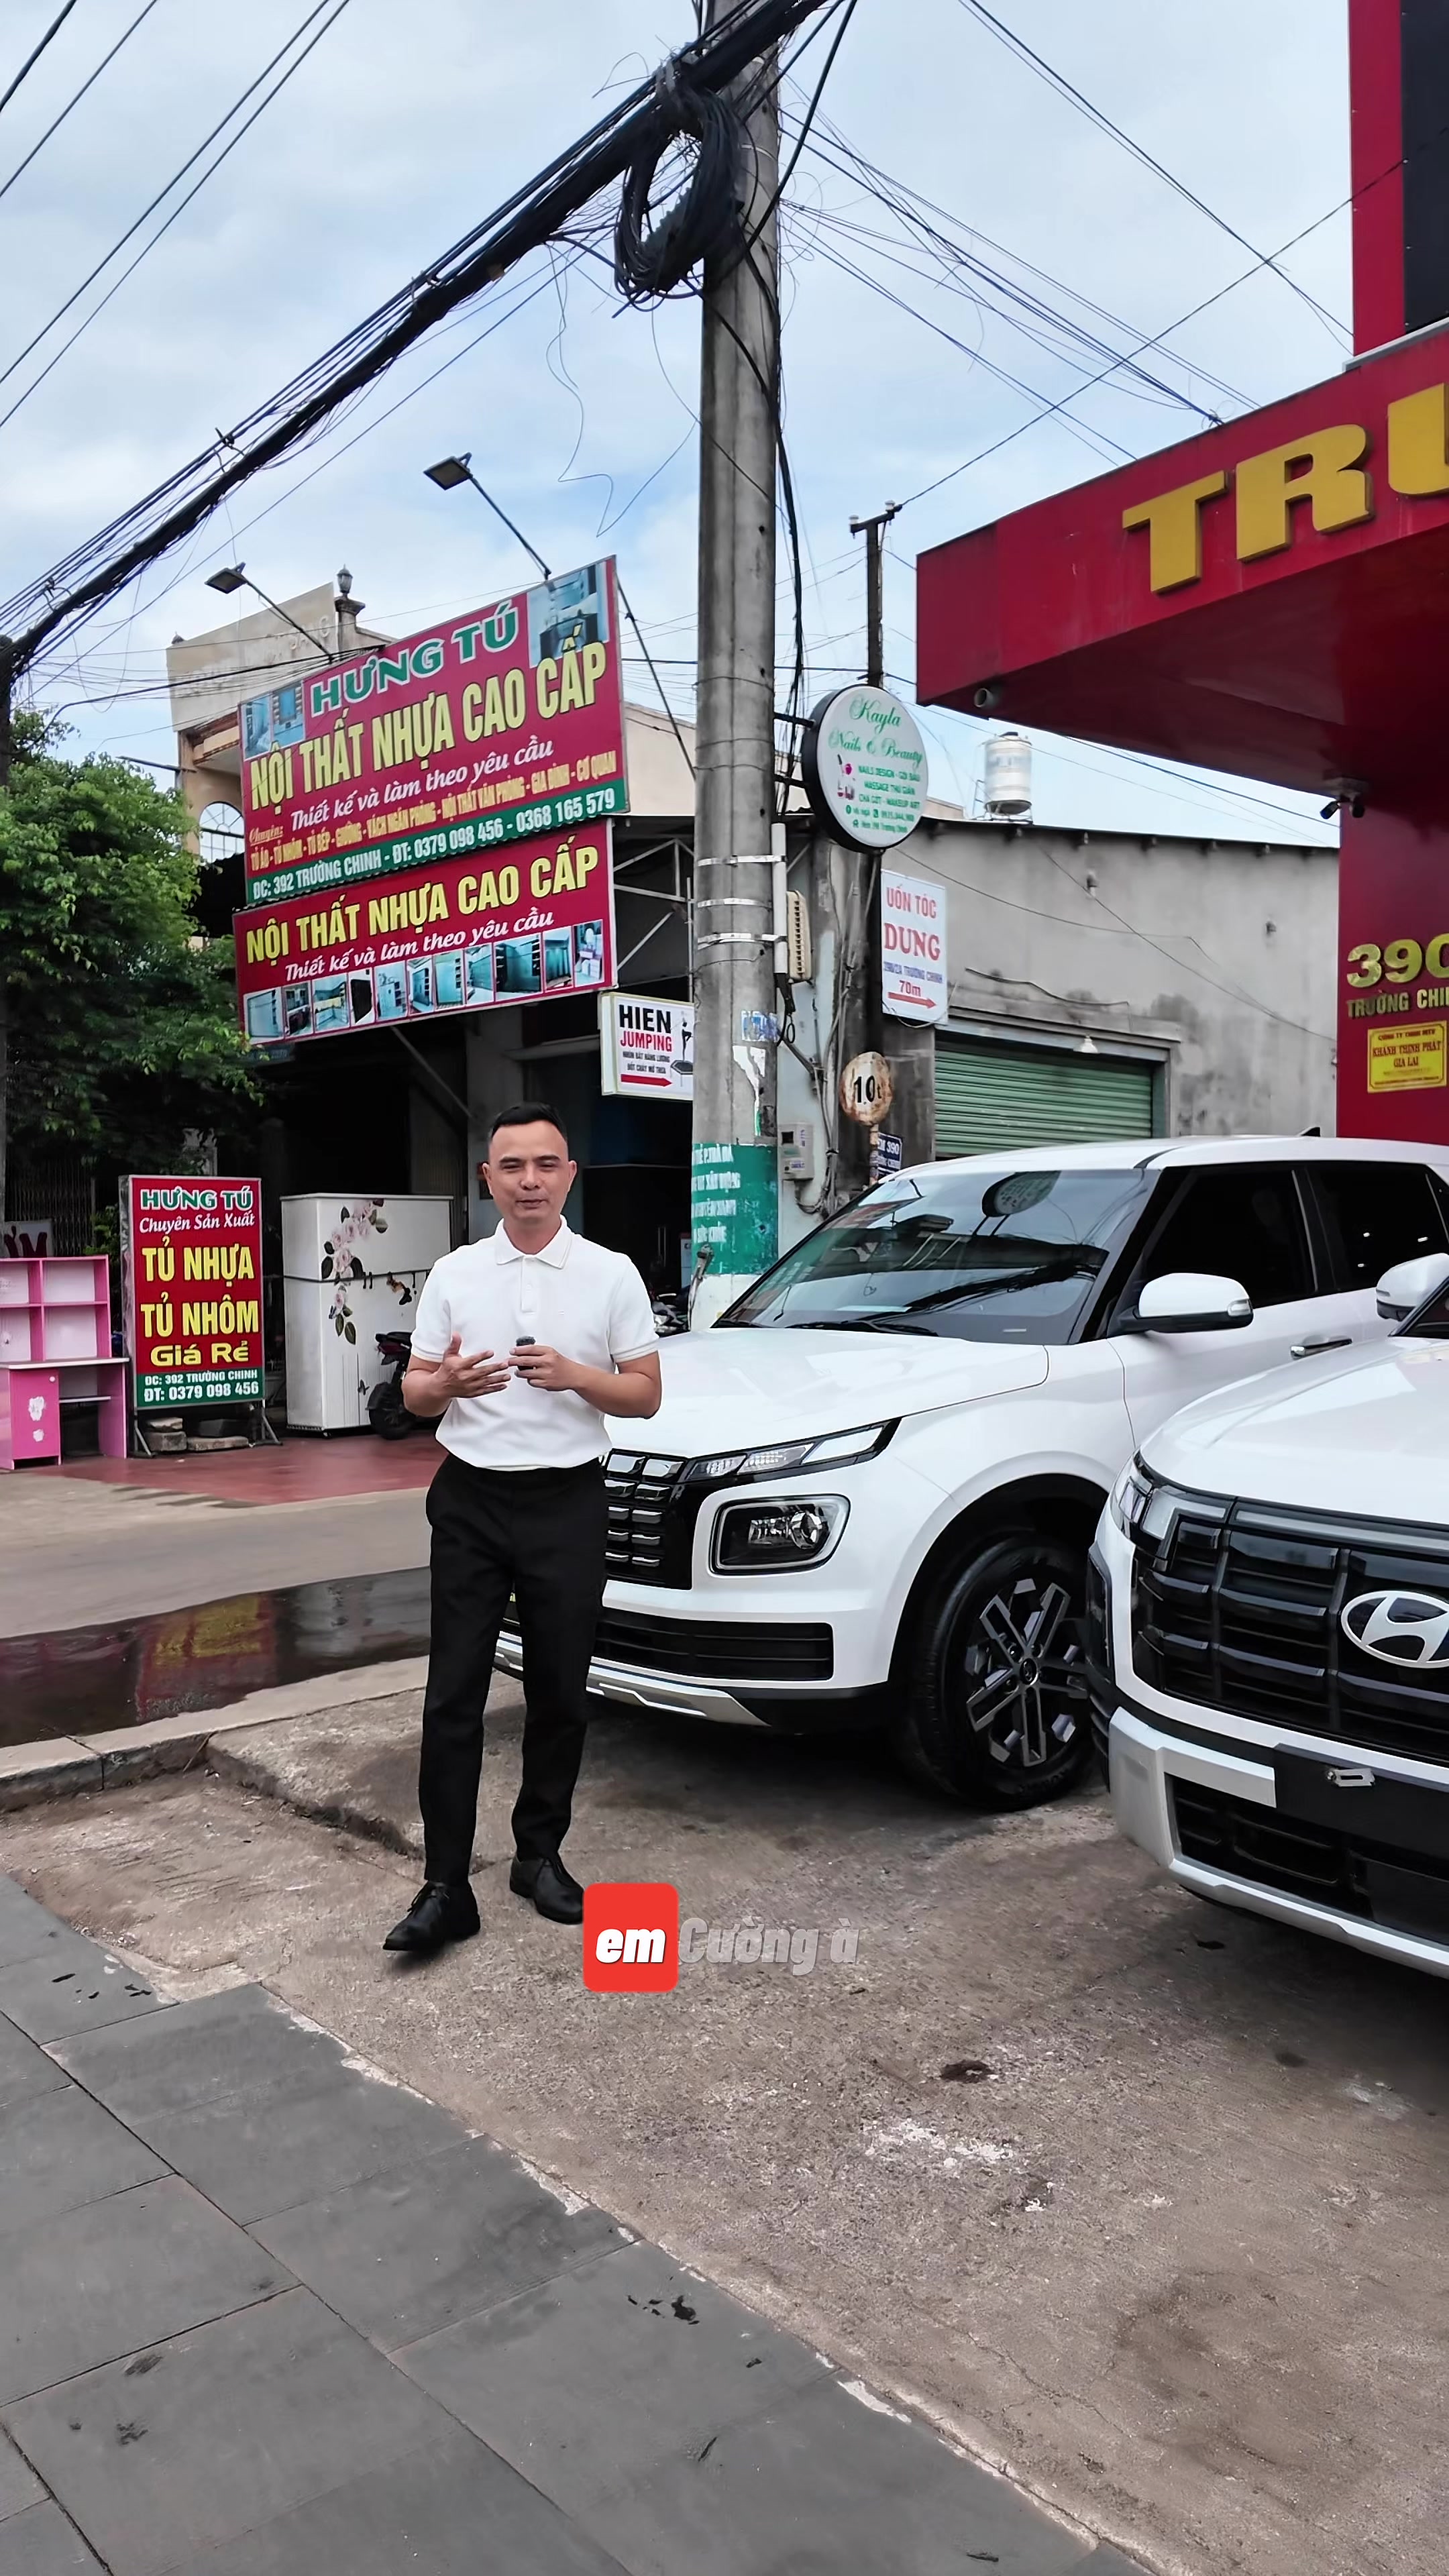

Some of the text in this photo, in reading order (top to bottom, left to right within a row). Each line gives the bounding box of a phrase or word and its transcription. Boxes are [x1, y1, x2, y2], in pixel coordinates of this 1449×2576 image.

[309, 636, 445, 718] HƯNG
[450, 599, 521, 665] TÚ
[250, 624, 608, 816] NỘI THẤT NHỰA CAO CẤP
[849, 695, 902, 734] Kayla
[828, 727, 861, 752] Nails
[881, 738, 923, 769] Beauty
[290, 735, 555, 831] Thiết kế và làm theo yêu cầu
[252, 788, 615, 900] ĐC: 392 TRƯỜNG CHINH ĐT: 0379 098 456 0368 165 579
[246, 835, 600, 964] NỘI THẤT NHỰA CAO CẤP
[886, 883, 936, 919] UỐN TÓC
[285, 906, 555, 982] Thiết kế và làm theo yêu cầu
[883, 922, 941, 961] DUNG
[899, 980, 921, 997] 70m
[1346, 986, 1449, 1018] TRƯỜNG CHI
[619, 1004, 671, 1033] HIEN
[620, 1030, 672, 1052] JUMPING
[140, 1185, 253, 1211] HƯNG TÚ
[140, 1210, 255, 1234] Chuyên Sản Xuất
[142, 1236, 255, 1287] TỦ NHỰA
[140, 1291, 259, 1338] TỦ NHÔM
[151, 1341, 249, 1366] Giá Rẻ
[144, 1381, 259, 1402] ĐT: 0379 098 456
[145, 1369, 258, 1385] ĐC: 392 TRƯỜNG CHINH
